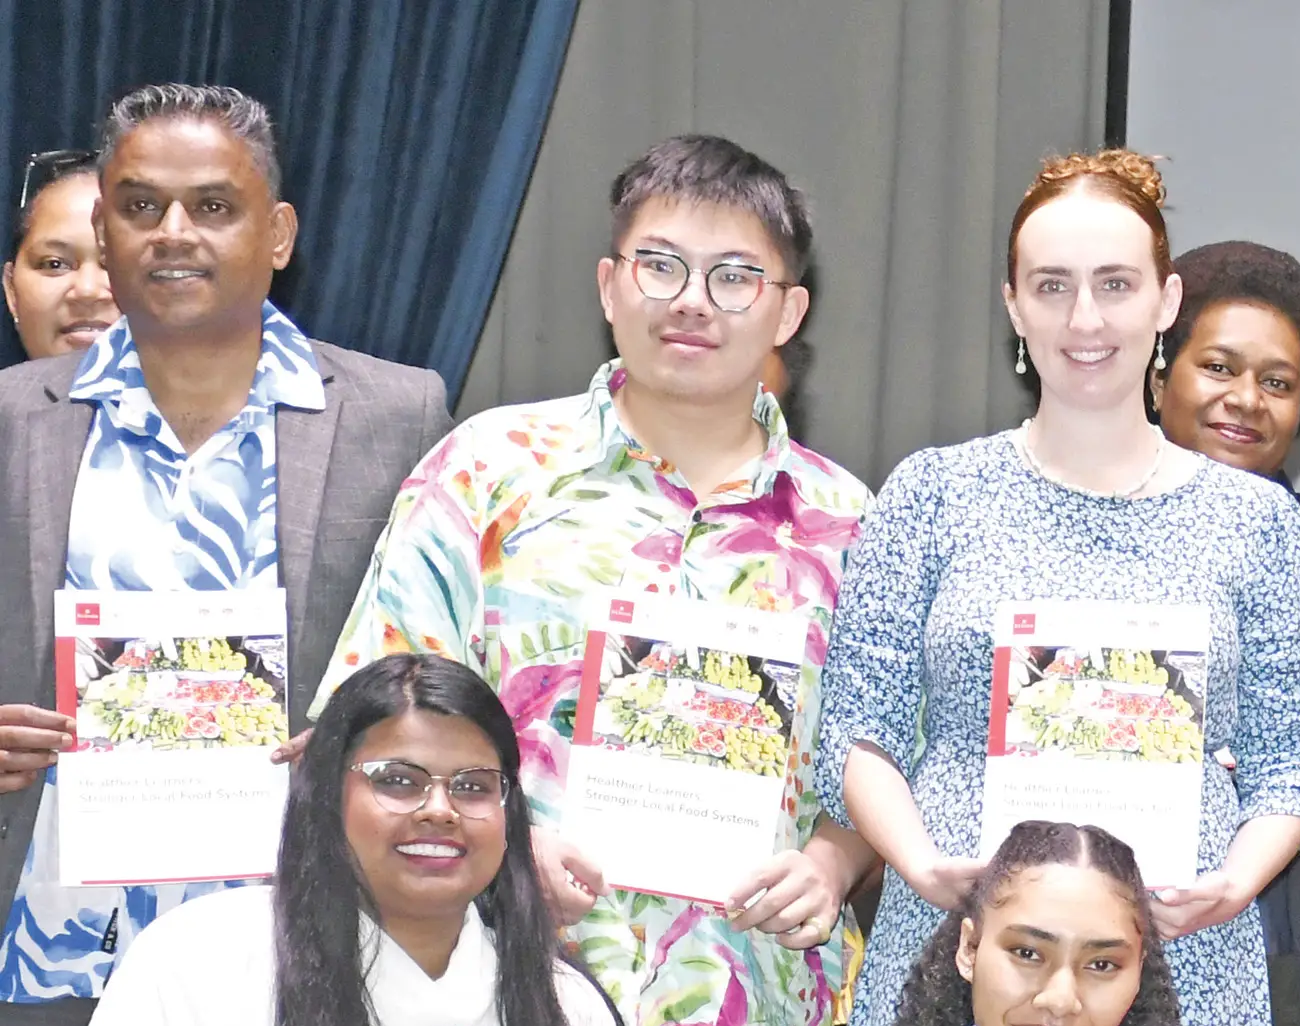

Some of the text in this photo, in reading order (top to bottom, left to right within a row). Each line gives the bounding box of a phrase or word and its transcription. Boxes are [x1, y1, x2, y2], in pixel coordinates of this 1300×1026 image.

[586, 775, 643, 791] Healthier
[585, 787, 760, 828] Stronger Local Food Systems
